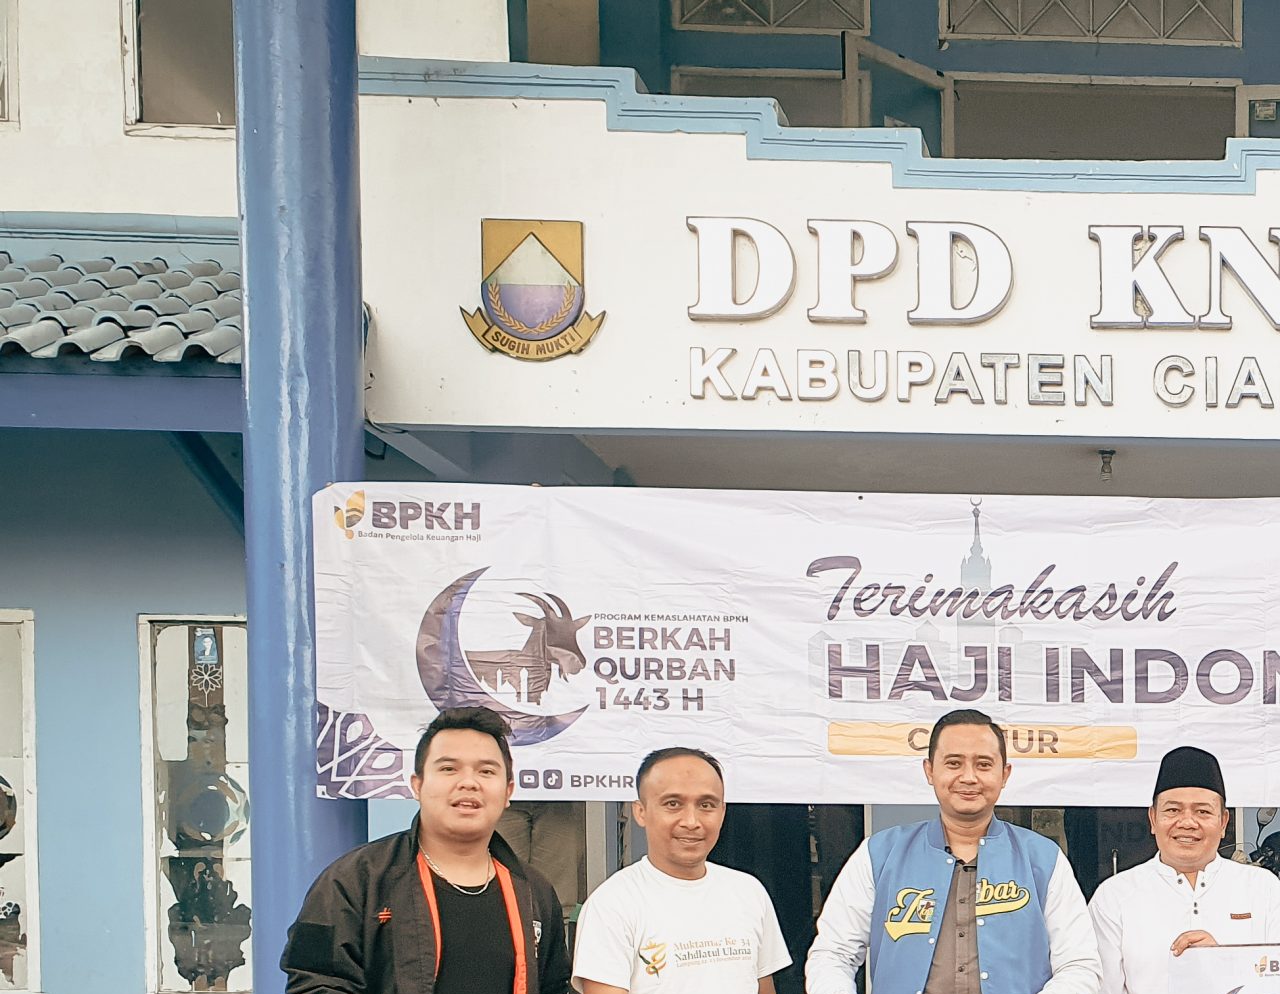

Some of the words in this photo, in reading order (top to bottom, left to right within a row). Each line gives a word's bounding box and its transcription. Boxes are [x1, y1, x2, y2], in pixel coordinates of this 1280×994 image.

[686, 216, 1014, 326] DPD
[491, 331, 530, 354] SUGIH
[536, 333, 576, 355] MUKTI
[689, 346, 1113, 407] KABUPATEN
[371, 501, 481, 531] BPKH
[358, 530, 383, 539] Badan
[385, 532, 424, 542] Pengelola
[426, 534, 464, 542] Keuangan
[466, 534, 482, 543] Haji
[806, 555, 1179, 622] Terimakasih
[594, 613, 641, 621] PROGRAM
[644, 614, 720, 622] KEMASLAHATAN
[723, 615, 749, 623] BPKH
[593, 626, 731, 651] BERKAH
[593, 656, 736, 685] QURBAN
[827, 643, 1013, 701] HAJI
[595, 686, 671, 711] 1443
[682, 687, 704, 711] H
[675, 948, 720, 961] Nahdlatul
[723, 947, 752, 956] Ulama
